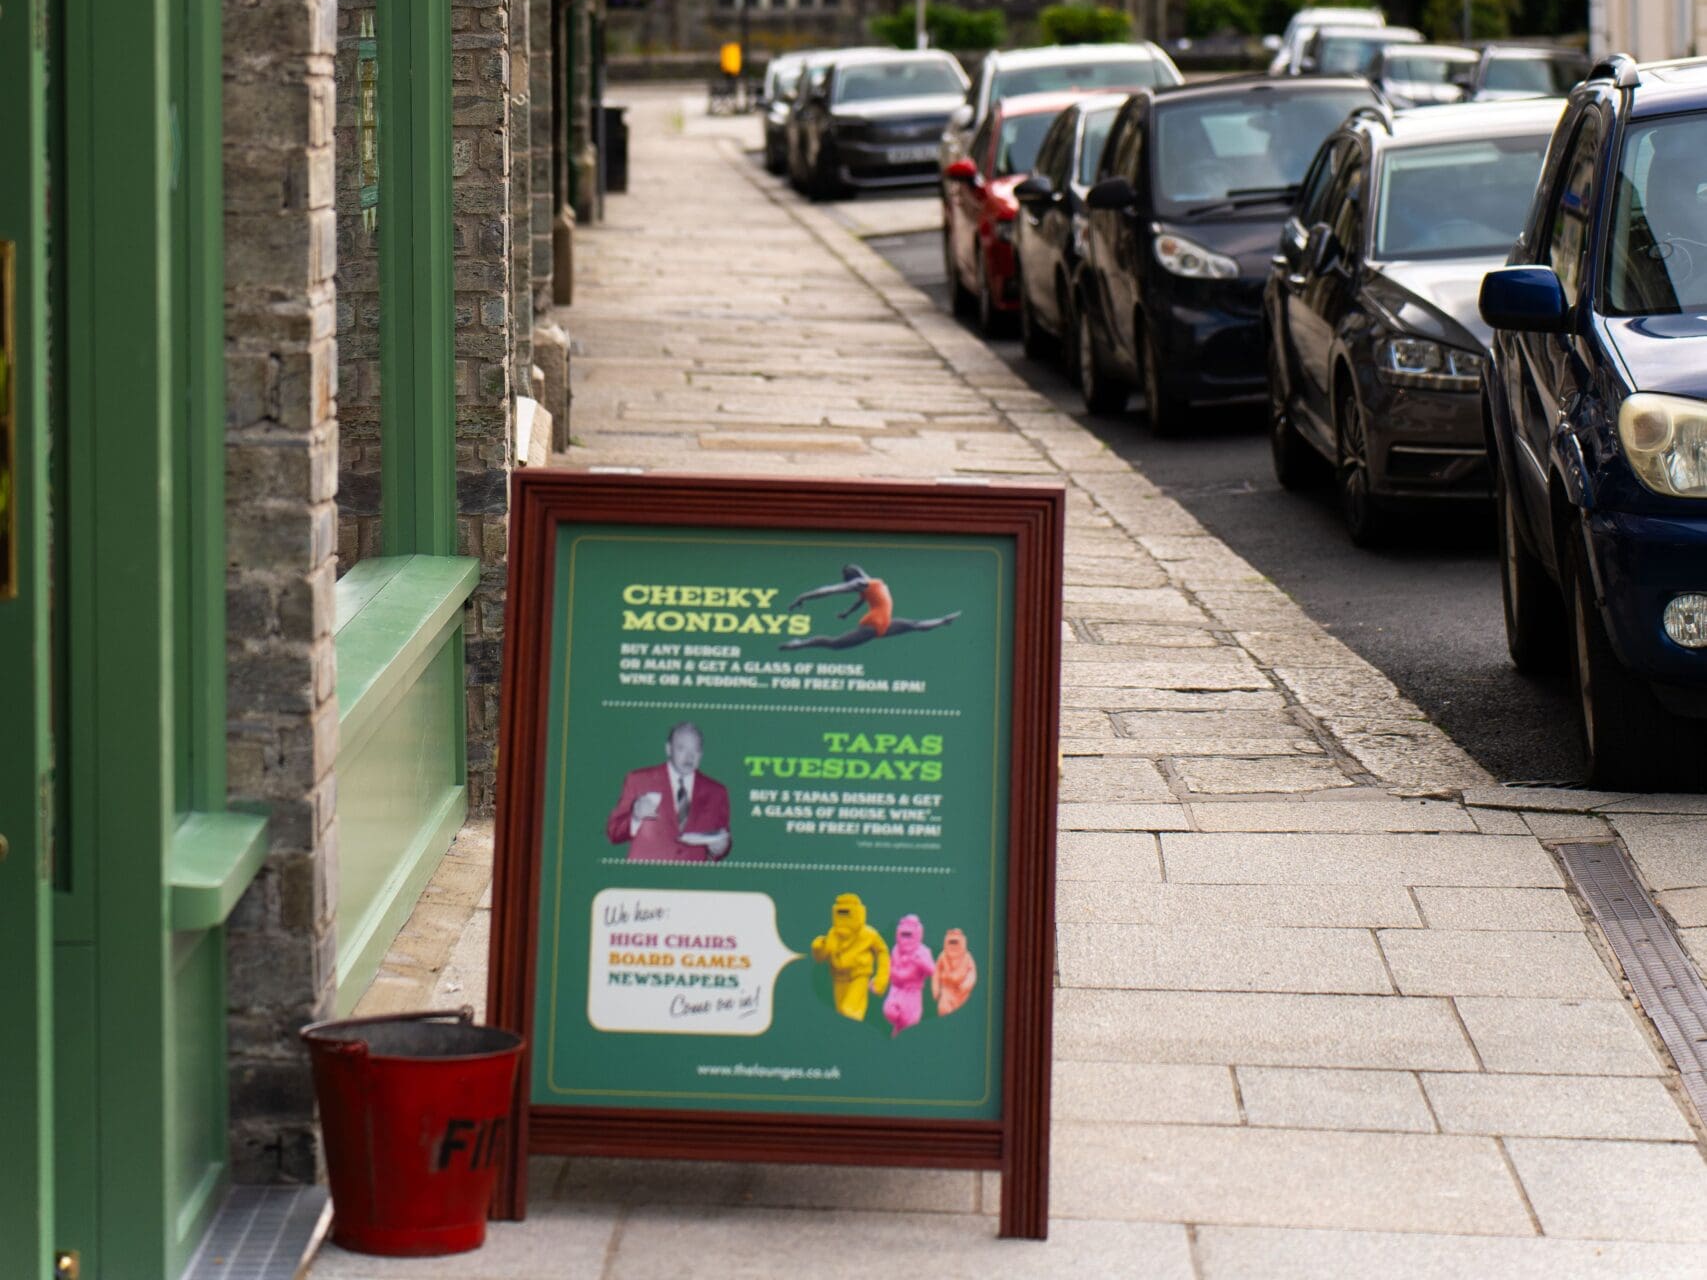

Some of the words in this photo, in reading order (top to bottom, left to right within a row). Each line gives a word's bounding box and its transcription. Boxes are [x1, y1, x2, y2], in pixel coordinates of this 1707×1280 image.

[623, 585, 778, 608] CHEEKY
[622, 610, 811, 635] MONDAYS
[620, 643, 649, 656] BUY
[651, 644, 681, 656] ANY
[684, 645, 741, 658] BURGER
[620, 659, 641, 670] OR
[644, 659, 681, 671] MAIN
[684, 660, 695, 671] &
[698, 660, 727, 673] GET
[730, 661, 741, 673] A
[743, 661, 791, 674] GLASS
[794, 663, 813, 675] OF
[816, 663, 864, 676] HOUSE
[619, 673, 656, 685] WINE
[659, 674, 680, 686] OR
[682, 674, 693, 686] A
[771, 677, 801, 689] FOR
[803, 678, 845, 691] FREE!
[847, 679, 889, 692] FROM
[823, 732, 943, 755] TAPAS
[744, 756, 943, 782] TUESDAYS
[749, 789, 778, 802] BUY
[793, 790, 839, 804] TAPAS
[842, 792, 896, 806] DISHES
[898, 794, 910, 806] &
[912, 794, 943, 807] GET
[751, 805, 762, 817] A
[764, 806, 813, 819] GLASS
[815, 807, 836, 819] OF
[838, 807, 887, 820] HOUSE
[786, 821, 815, 833] FOR
[818, 821, 860, 835] FREE!
[863, 822, 905, 836] FROM
[604, 901, 629, 926] We
[609, 932, 659, 947] HIGH
[664, 933, 738, 949] CHAIRS
[608, 951, 675, 967] BOARD
[680, 953, 752, 969] GAMES
[607, 972, 740, 988] NEWSPAPERS
[669, 994, 711, 1018] Come
[716, 998, 734, 1011] on
[738, 986, 761, 1011] in!
[696, 1062, 841, 1081] www.thelounges.co.uk
